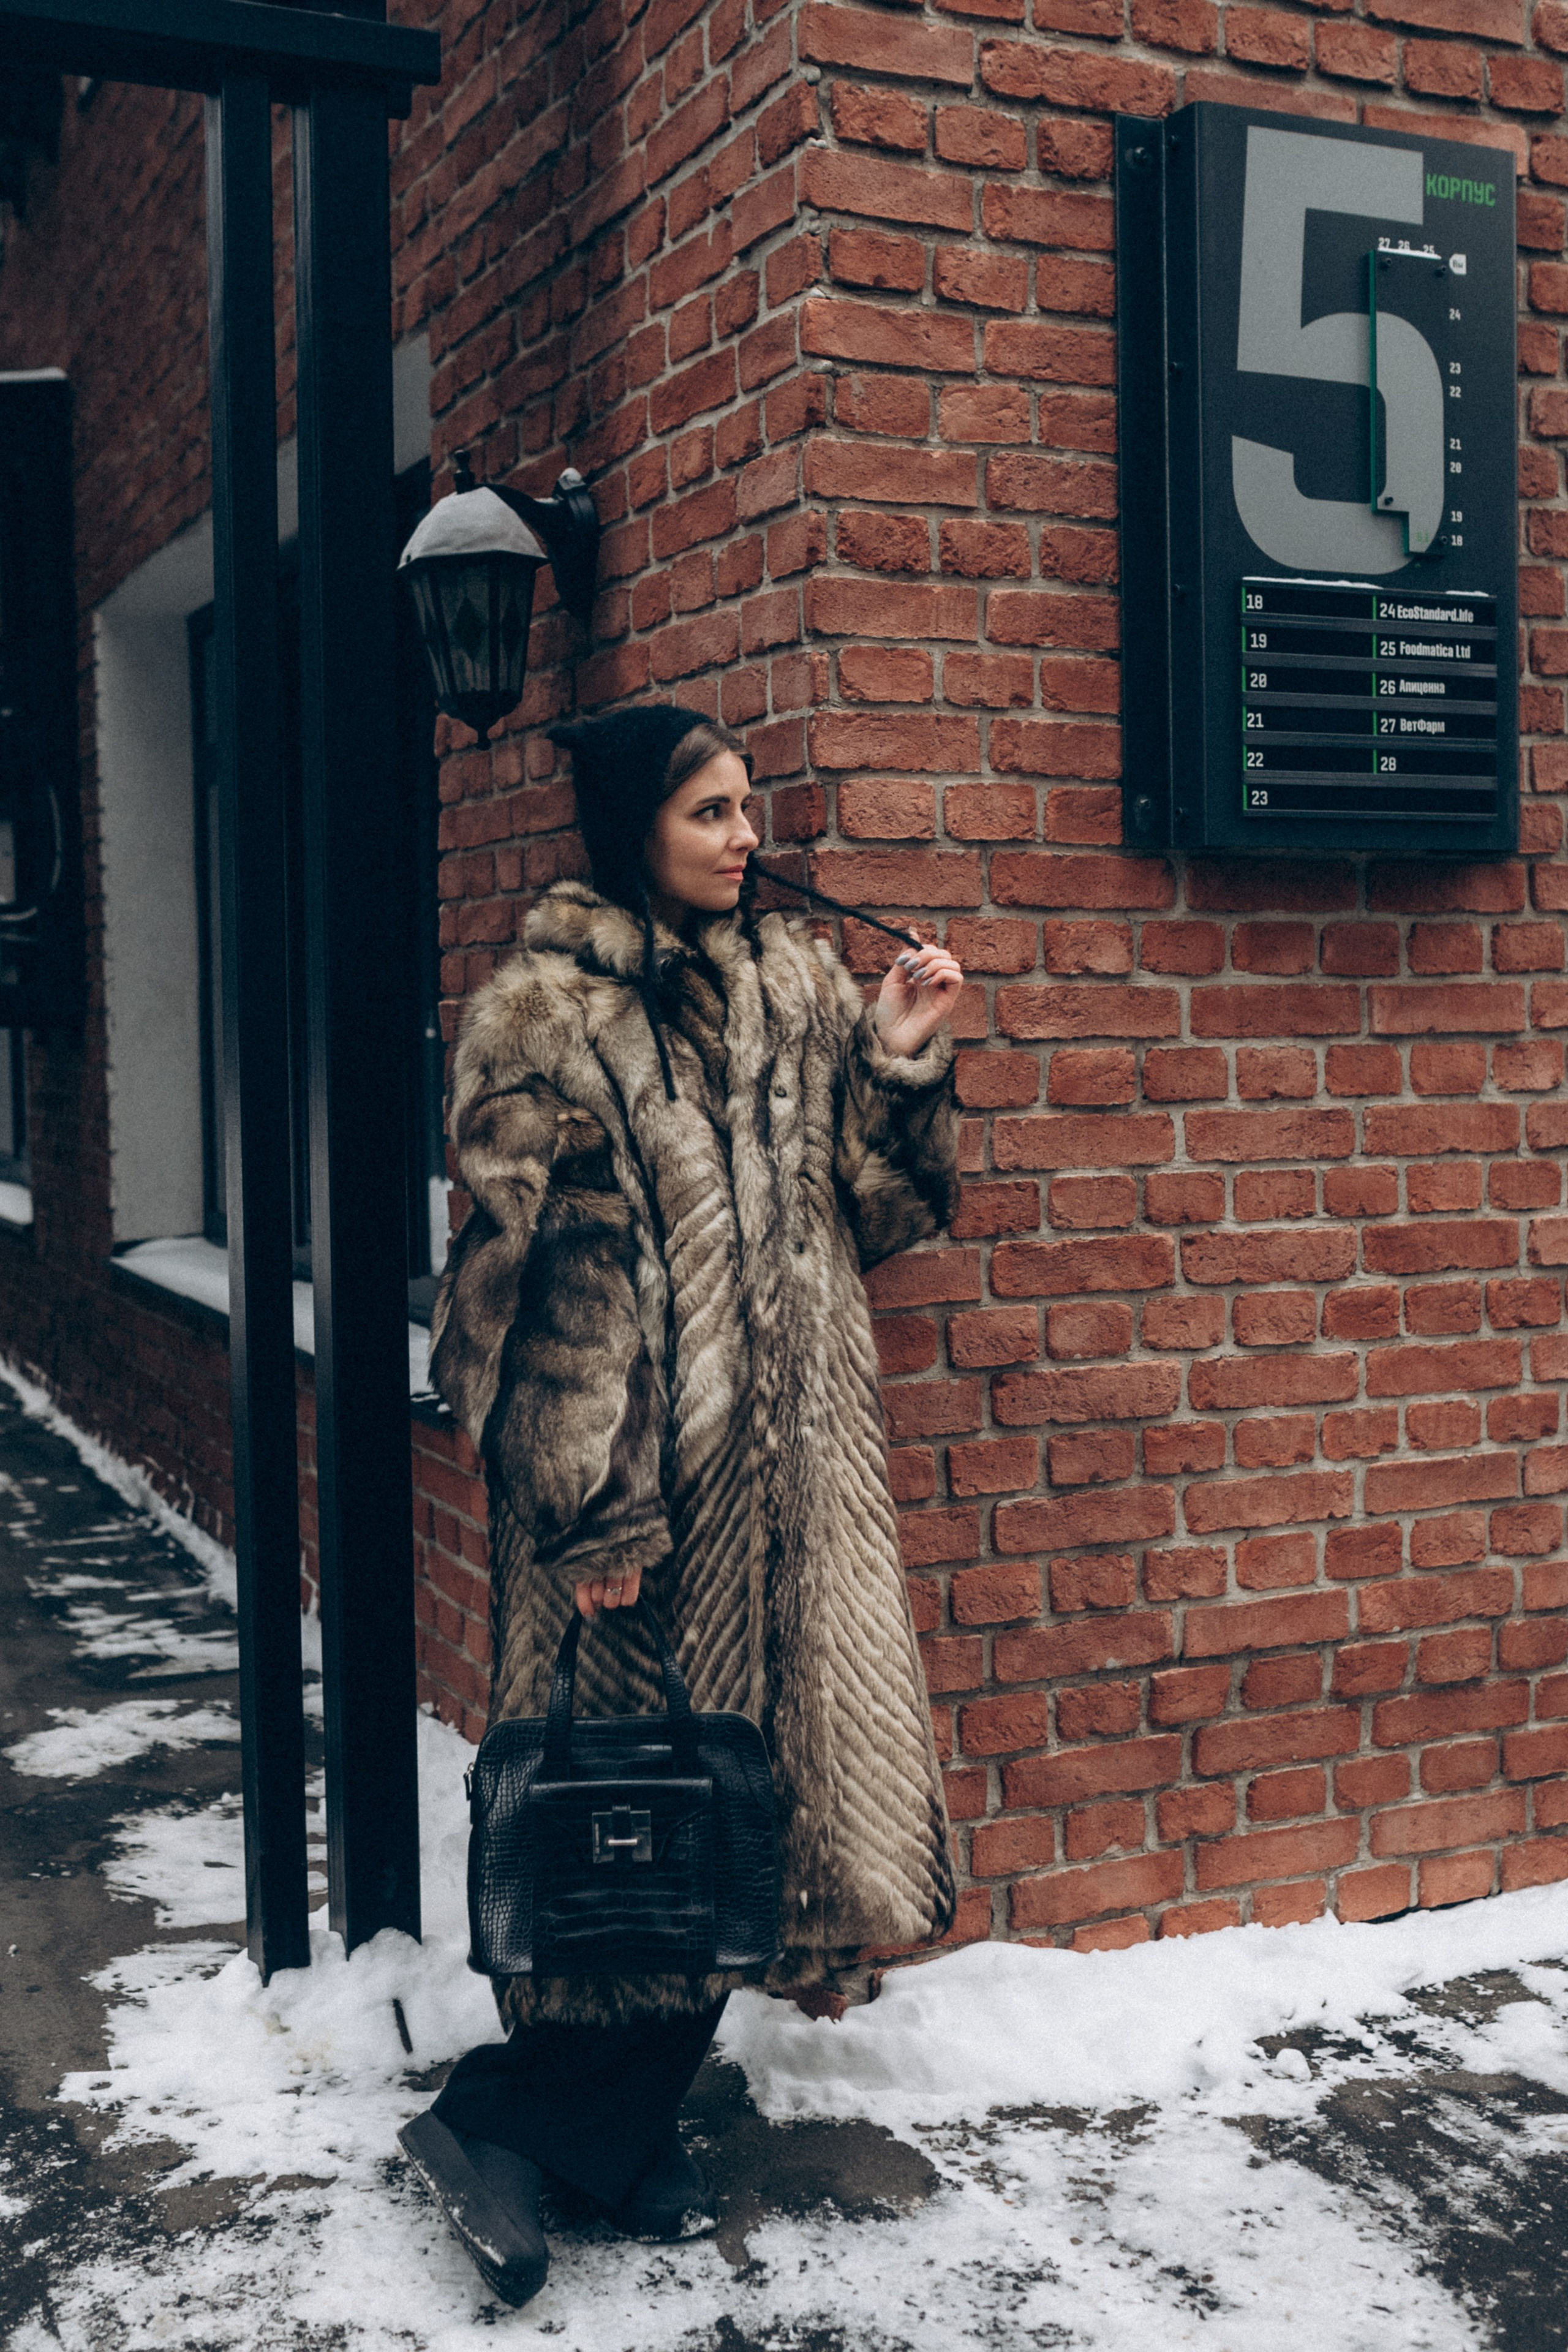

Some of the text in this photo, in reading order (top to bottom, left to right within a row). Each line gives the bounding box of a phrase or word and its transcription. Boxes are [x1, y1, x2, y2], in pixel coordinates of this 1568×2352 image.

[1426, 173, 1495, 206] КОРПУС
[1379, 237, 1390, 249] 27
[1398, 239, 1410, 250] 26
[1423, 244, 1435, 254] 25
[1449, 308, 1461, 320] 24
[1232, 126, 1444, 575] 5
[1449, 362, 1461, 374] 23
[1449, 386, 1461, 398] 22
[1450, 438, 1461, 450] 21
[1450, 462, 1461, 473] 20
[1451, 511, 1463, 522] 19
[1451, 535, 1463, 546] 18
[1246, 594, 1263, 609] 18
[1380, 603, 1395, 618] 24
[1251, 633, 1267, 648] 19
[1381, 641, 1471, 658] 25 Foodmatica Ltd
[1250, 673, 1267, 688] 20
[1380, 679, 1446, 695] 26 Апиценна
[1247, 713, 1264, 728] 21
[1381, 718, 1446, 734] 27 ВетФарм
[1247, 752, 1264, 767] 22
[1381, 756, 1396, 771] 28
[1251, 790, 1268, 805] 23
